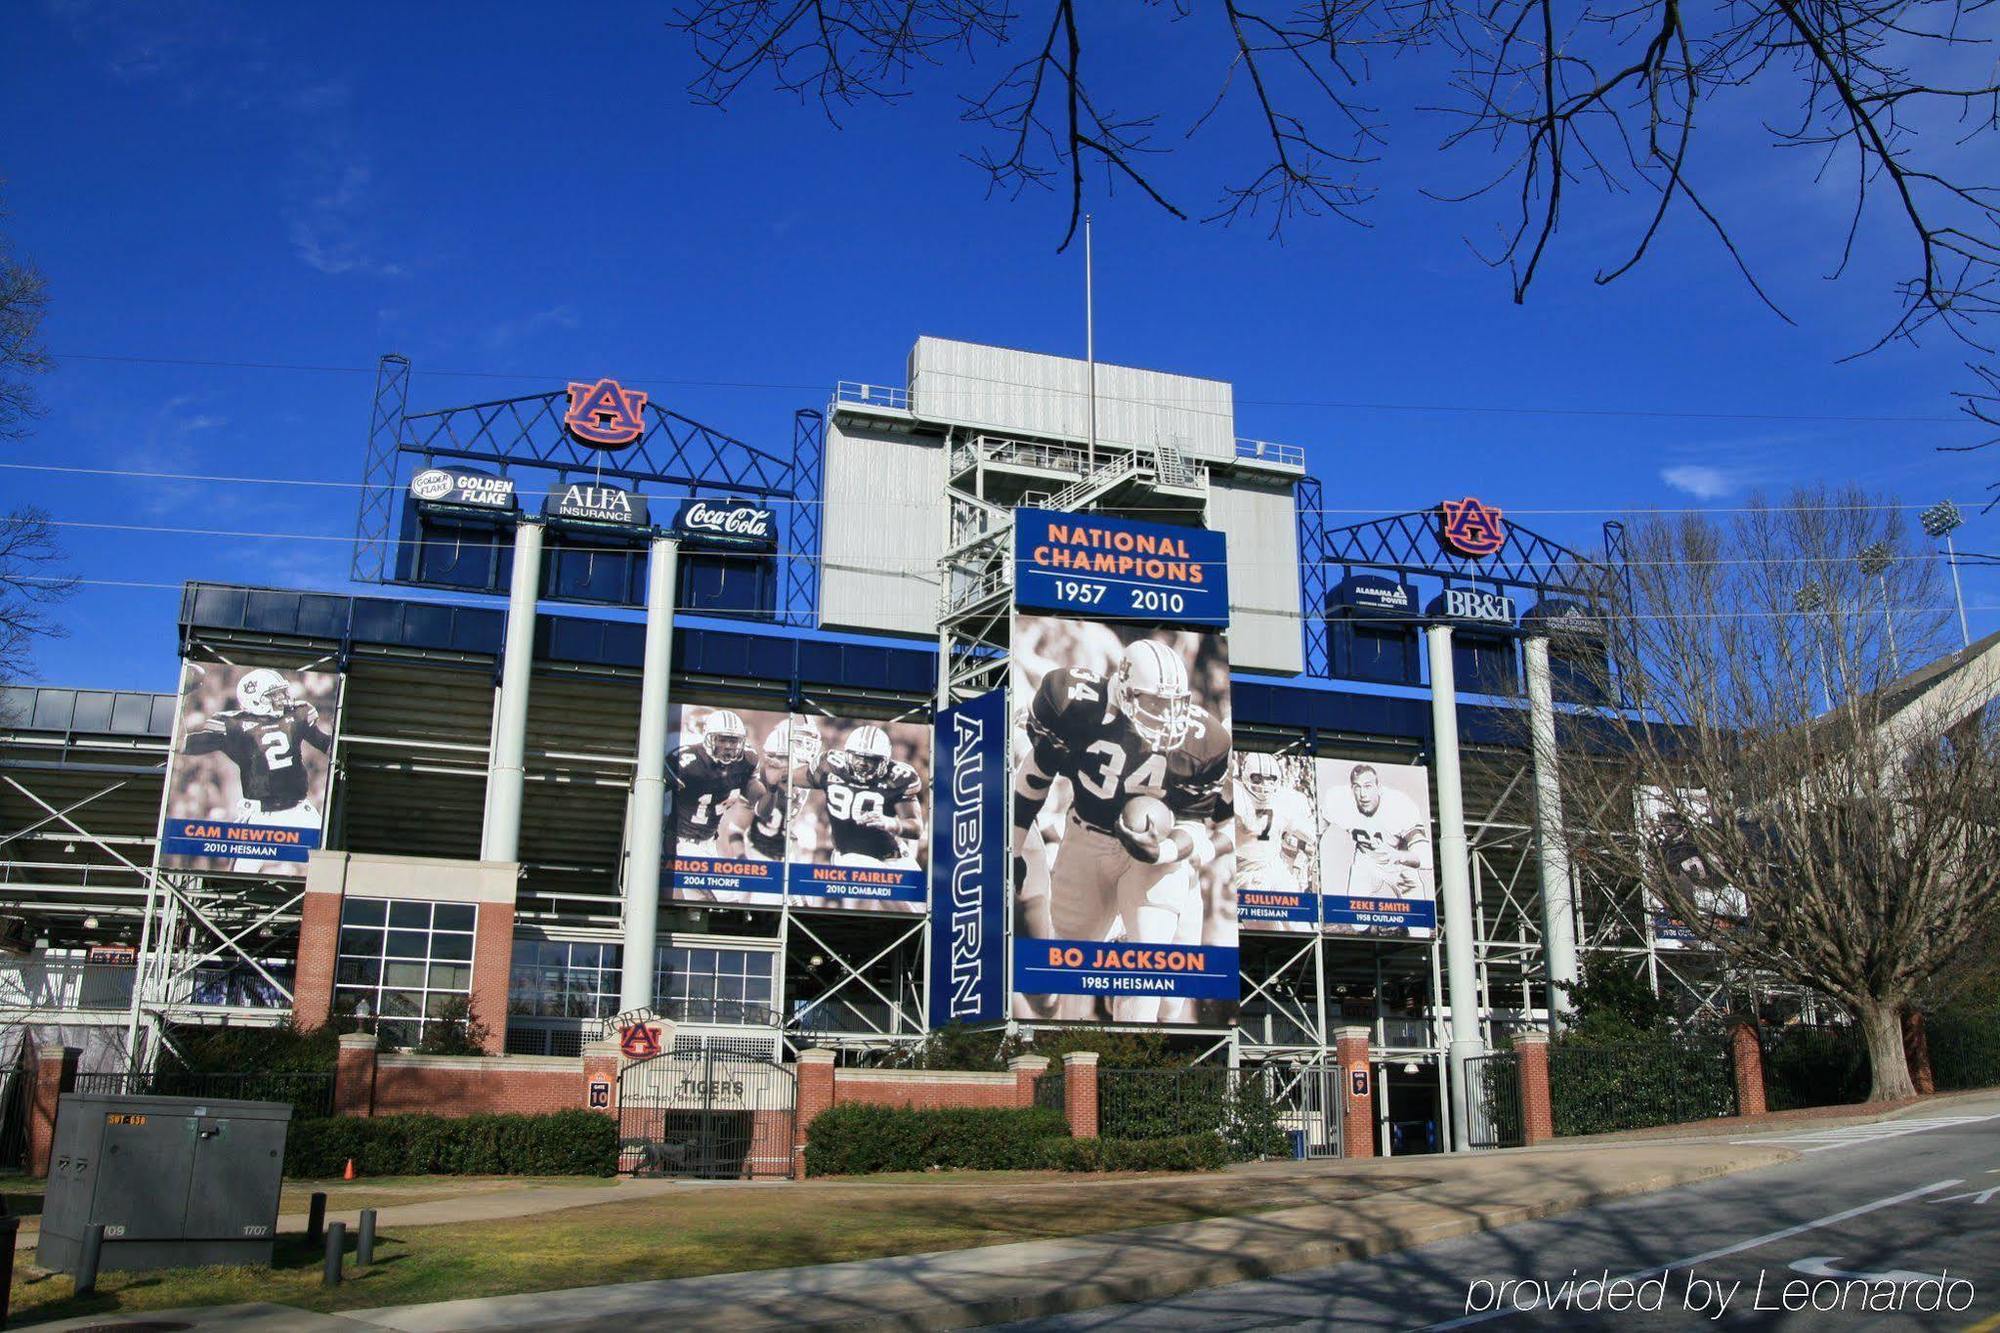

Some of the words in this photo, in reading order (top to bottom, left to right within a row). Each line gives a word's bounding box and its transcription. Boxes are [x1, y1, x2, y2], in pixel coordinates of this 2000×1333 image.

[416, 474, 449, 487] GOLDEN
[420, 482, 449, 496] FLAKE
[457, 475, 514, 493] GOLDEN
[462, 489, 507, 506] FLAKE
[561, 484, 632, 512] ALFA
[559, 505, 632, 523] INSURANCE
[685, 502, 771, 537] Coca-Cola
[1048, 523, 1190, 559] NATIONAL
[1033, 546, 1204, 584] CHAMPIONS
[1055, 580, 1107, 605] 1957
[1131, 588, 1184, 613] 2010
[1355, 586, 1393, 597] ALABAMA
[1381, 596, 1408, 606] POWER
[1444, 589, 1515, 623] BB&T
[261, 731, 294, 771] 2
[1078, 739, 1168, 800] 34
[827, 784, 885, 825] 90
[184, 824, 222, 839] CAM
[227, 826, 300, 844] NEWTON
[203, 843, 227, 853] 2010
[229, 844, 277, 857] HEISMAN
[714, 861, 768, 876] ROGERS
[951, 711, 983, 1018] AUBURN
[683, 875, 705, 885] 2004
[707, 877, 740, 887] THORPE
[813, 868, 847, 881] NICK
[851, 870, 903, 885] FAIRLEY
[826, 884, 846, 894] 2010
[848, 886, 892, 897] LOMBARDI
[1244, 893, 1299, 907] SULLIVAN
[1350, 900, 1374, 911] ZEKE
[1378, 901, 1411, 912] SMITH
[1250, 908, 1289, 918] HEISMAN
[1356, 913, 1371, 922] 1958
[1372, 914, 1404, 924] OUTLAND
[1049, 947, 1083, 967] BO
[1092, 948, 1205, 971] JACKSON
[1081, 976, 1110, 989] 1985
[1112, 977, 1175, 991] HEISMAN
[681, 1078, 744, 1096] TIGERS
[591, 1091, 607, 1104] 10
